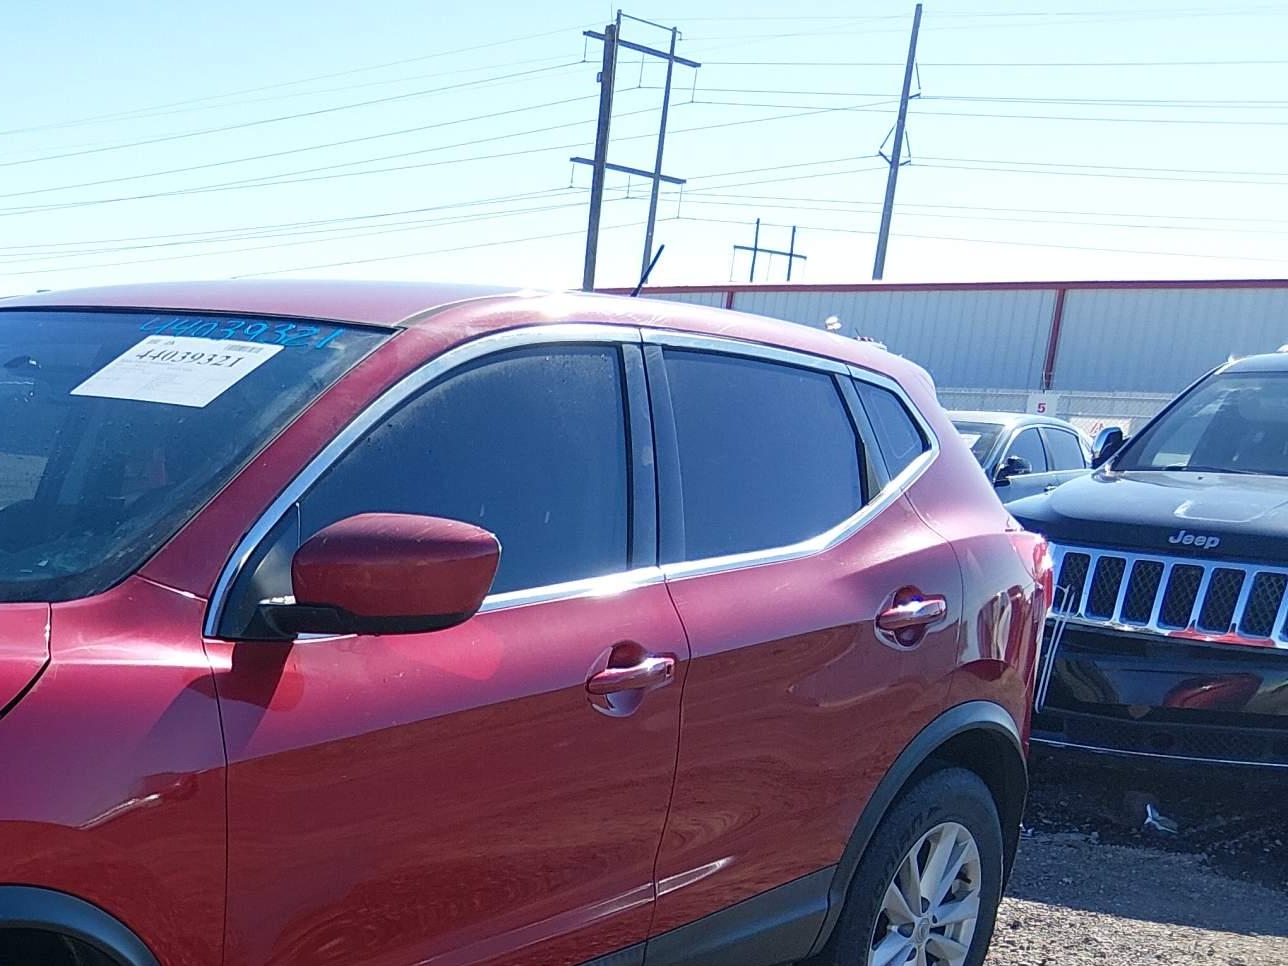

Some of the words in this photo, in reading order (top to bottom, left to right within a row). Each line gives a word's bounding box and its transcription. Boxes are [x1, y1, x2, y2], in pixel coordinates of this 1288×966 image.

[140, 317, 344, 350] 44039321
[136, 348, 245, 368] 44039321
[1036, 402, 1047, 414] 5
[1168, 530, 1220, 549] Jeep
